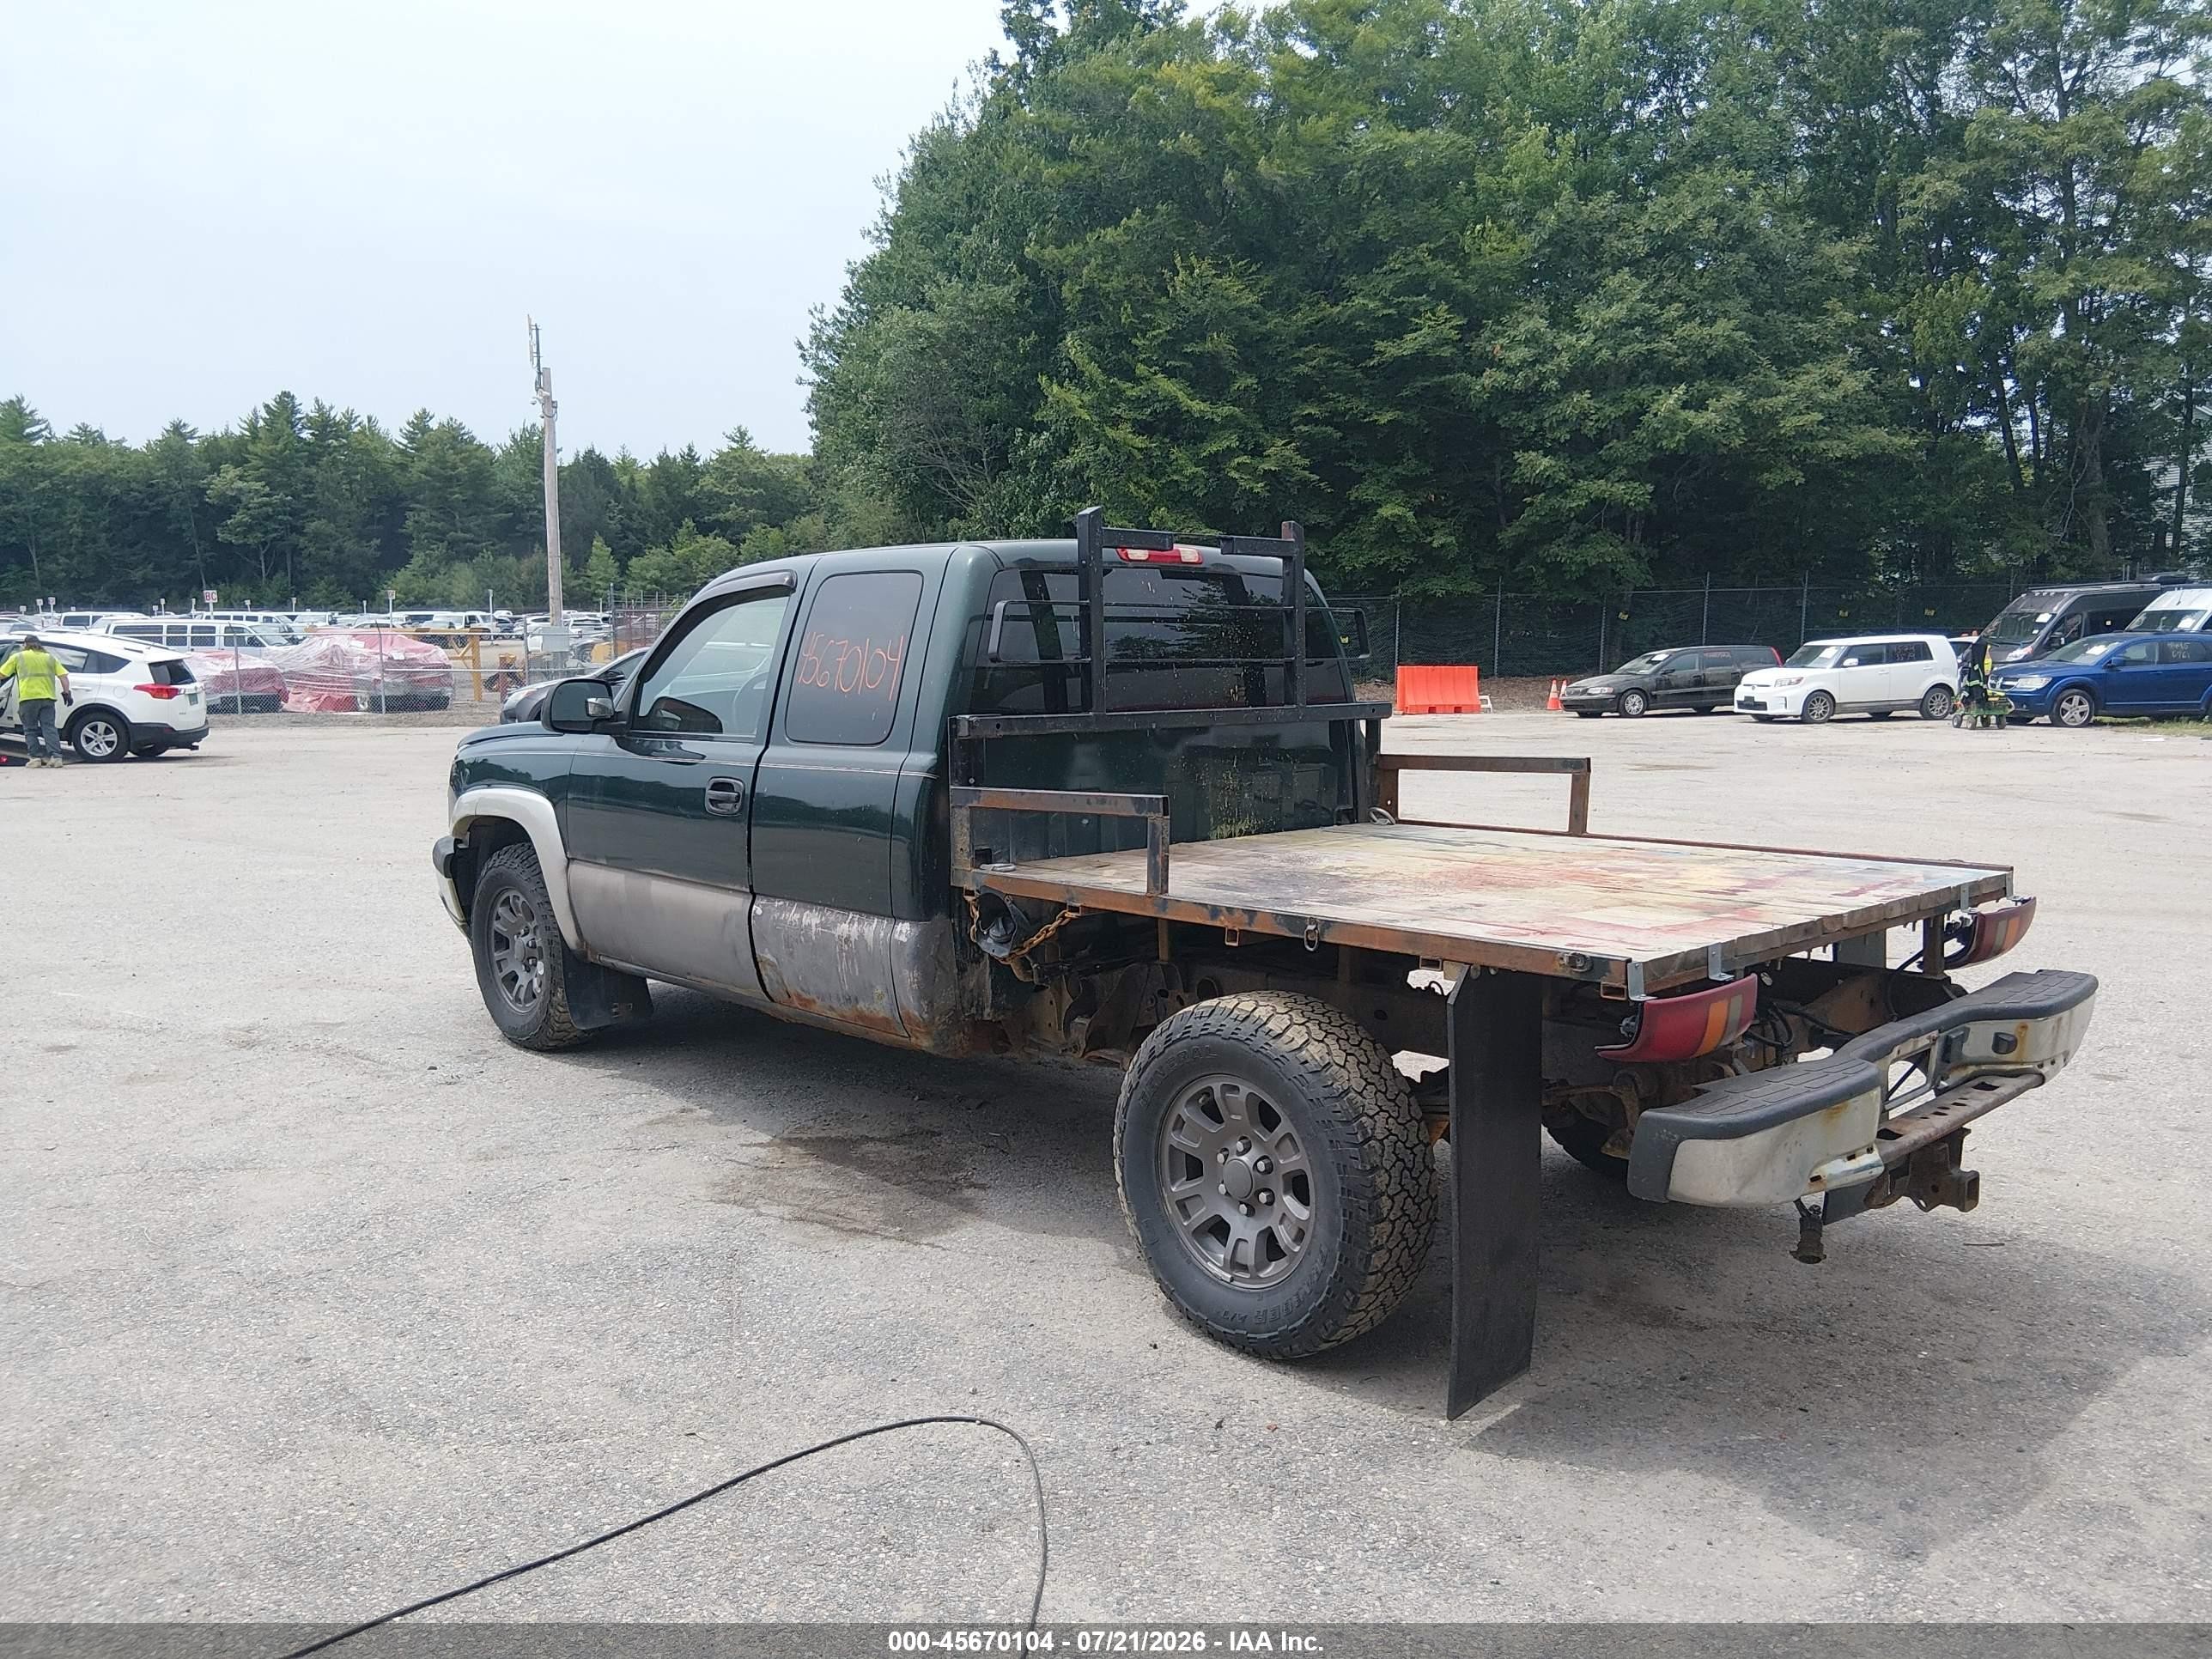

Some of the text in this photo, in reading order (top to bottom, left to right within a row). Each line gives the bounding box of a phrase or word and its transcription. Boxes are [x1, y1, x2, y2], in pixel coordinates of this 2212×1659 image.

[204, 591, 217, 601] BC
[798, 632, 905, 701] 45670104
[1139, 1044, 1219, 1107] GENERAL
